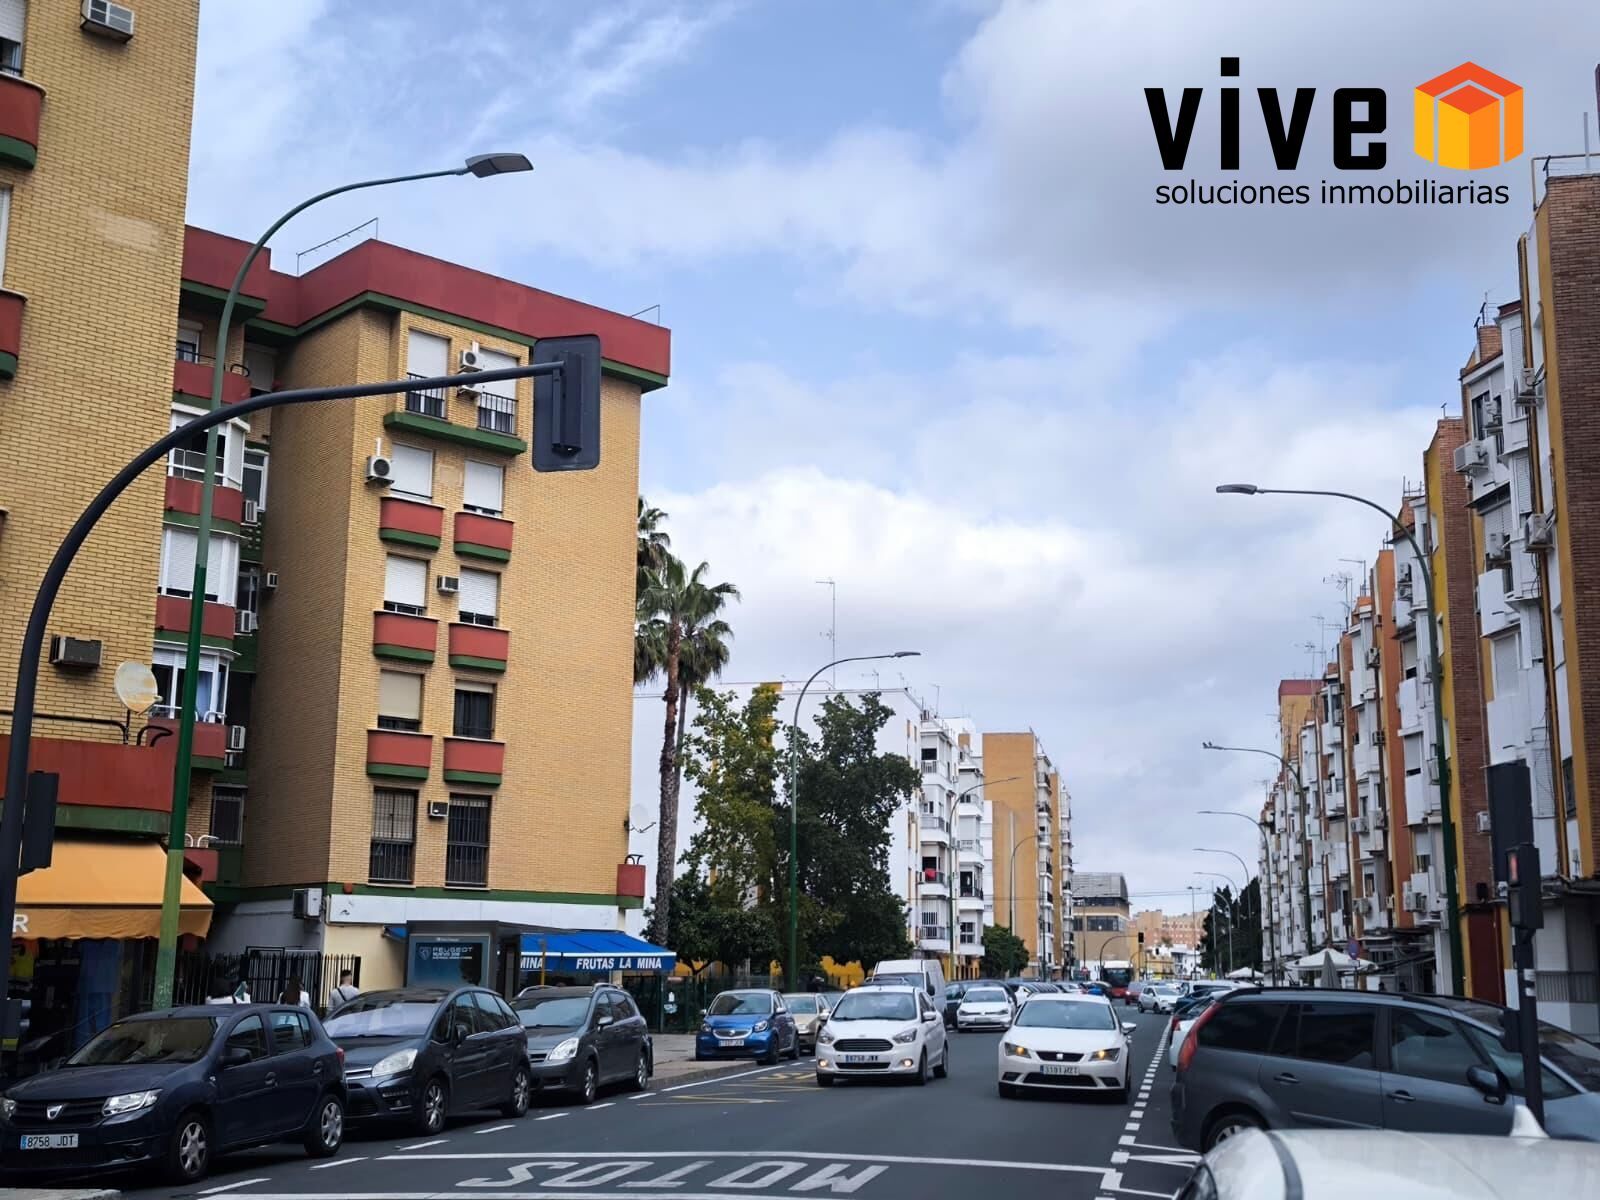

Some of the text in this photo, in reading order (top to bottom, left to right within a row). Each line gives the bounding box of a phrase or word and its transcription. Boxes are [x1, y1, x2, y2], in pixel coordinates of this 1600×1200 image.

[576, 957, 662, 970] FRUTAS LA MINA
[27, 1135, 75, 1147] 8758 JDT
[455, 1160, 890, 1193] MOTOS
